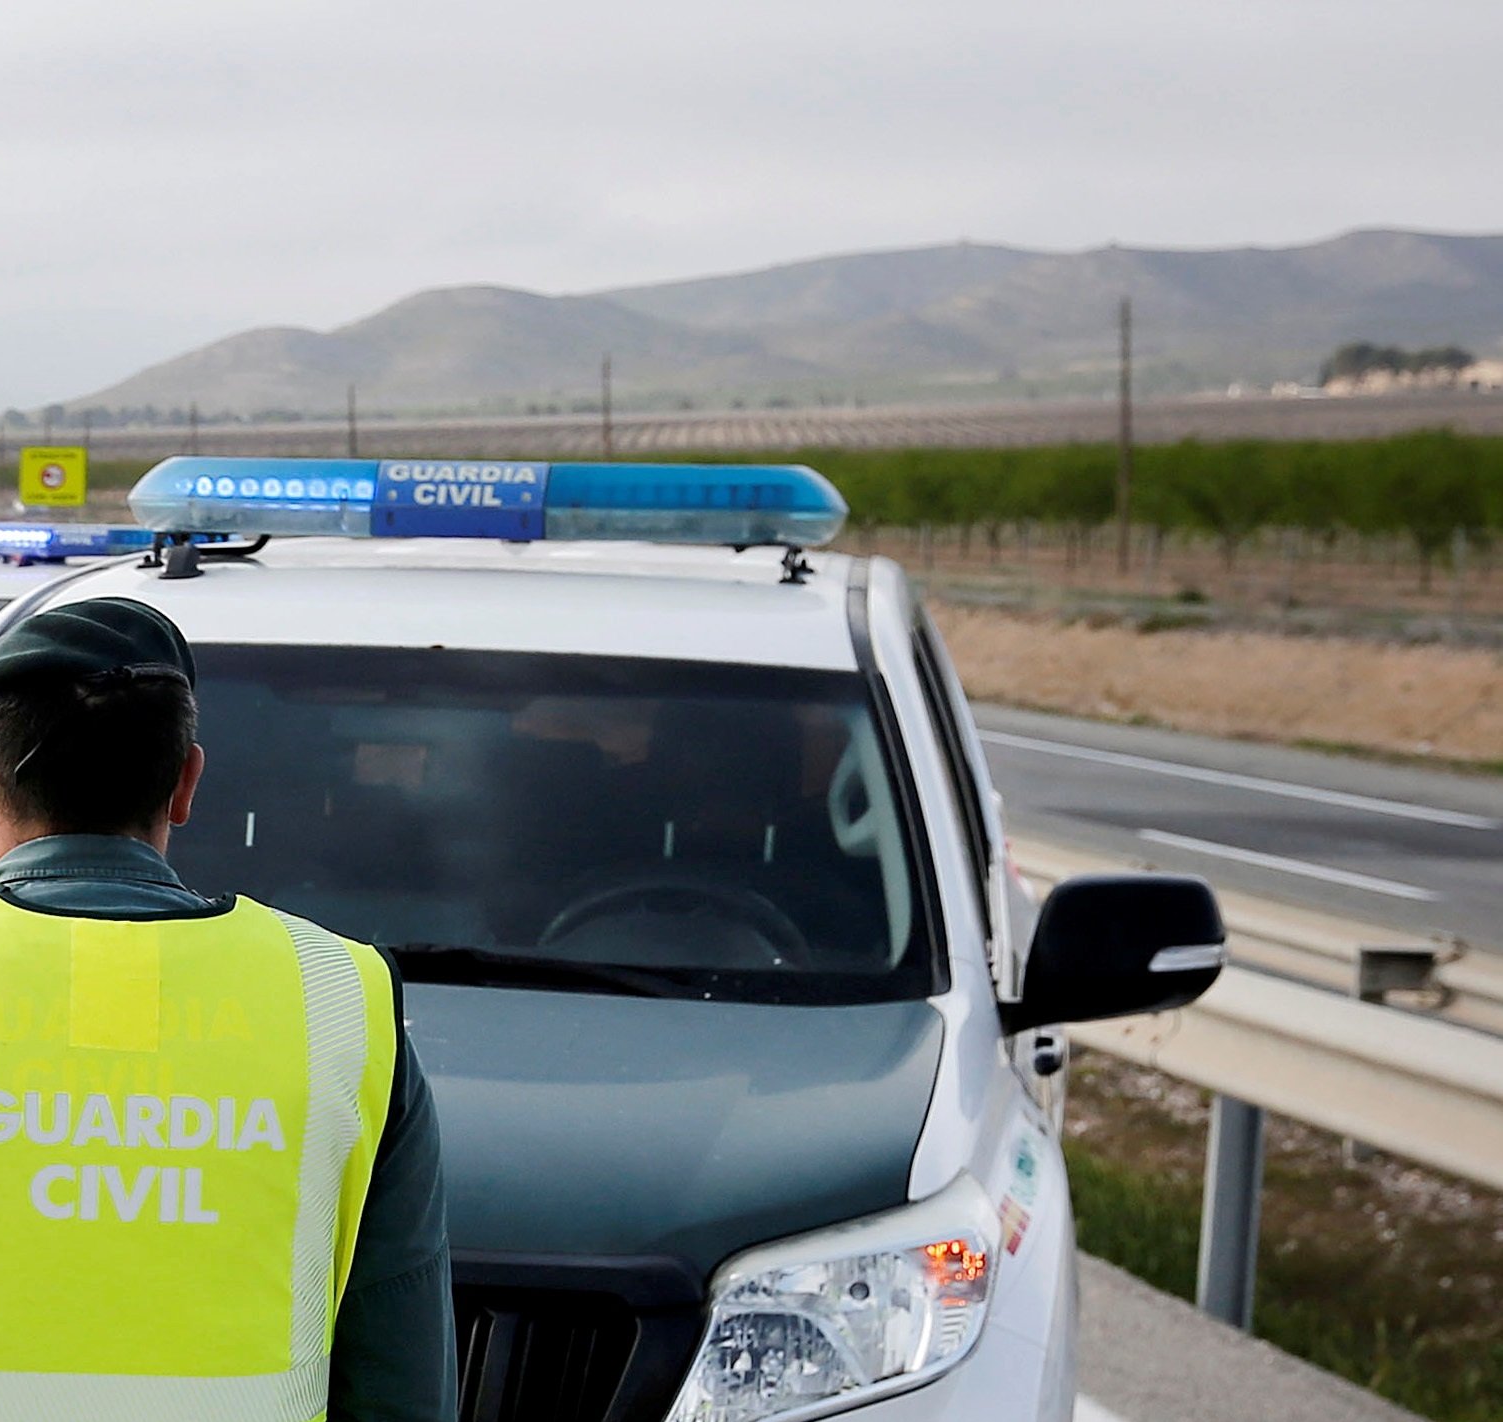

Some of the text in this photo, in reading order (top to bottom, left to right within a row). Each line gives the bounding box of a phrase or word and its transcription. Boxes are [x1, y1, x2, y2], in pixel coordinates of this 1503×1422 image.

[387, 464, 536, 484] GUARDIA
[413, 484, 502, 507] CIVIL
[29, 1163, 219, 1223] CIVIL
